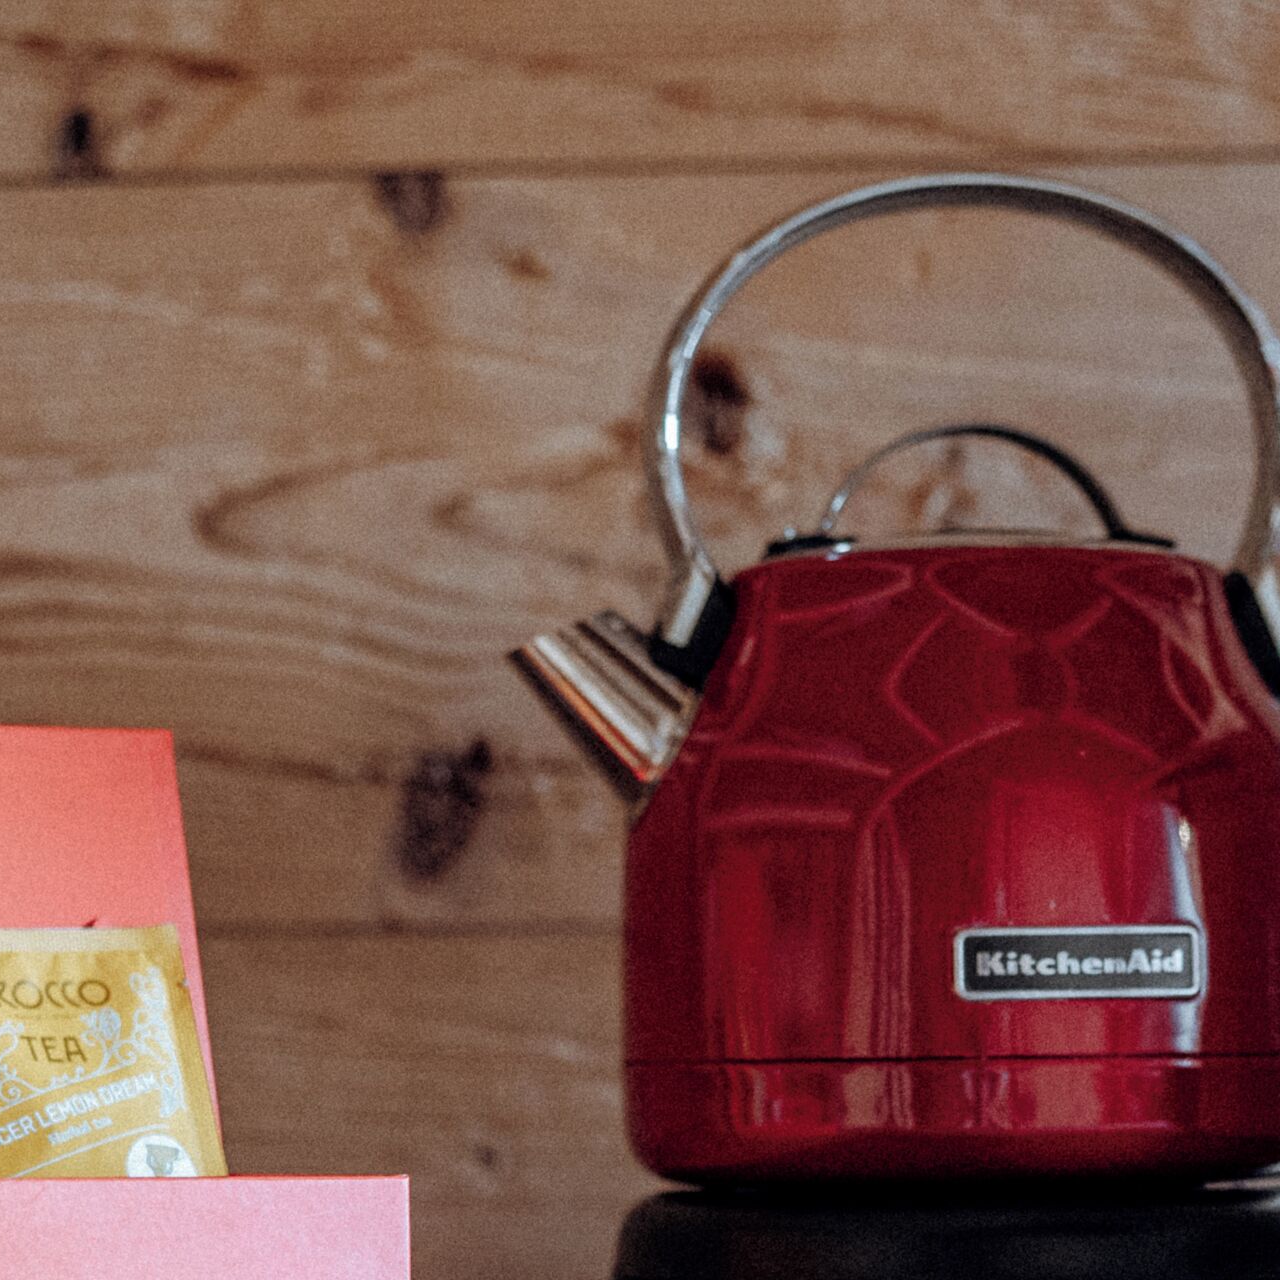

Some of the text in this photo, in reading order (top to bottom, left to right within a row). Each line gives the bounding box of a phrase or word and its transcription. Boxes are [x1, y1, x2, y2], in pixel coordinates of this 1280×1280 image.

[975, 947, 1184, 977] KitchenAid
[19, 1035, 88, 1063] TEA
[35, 1092, 100, 1128] LEMON
